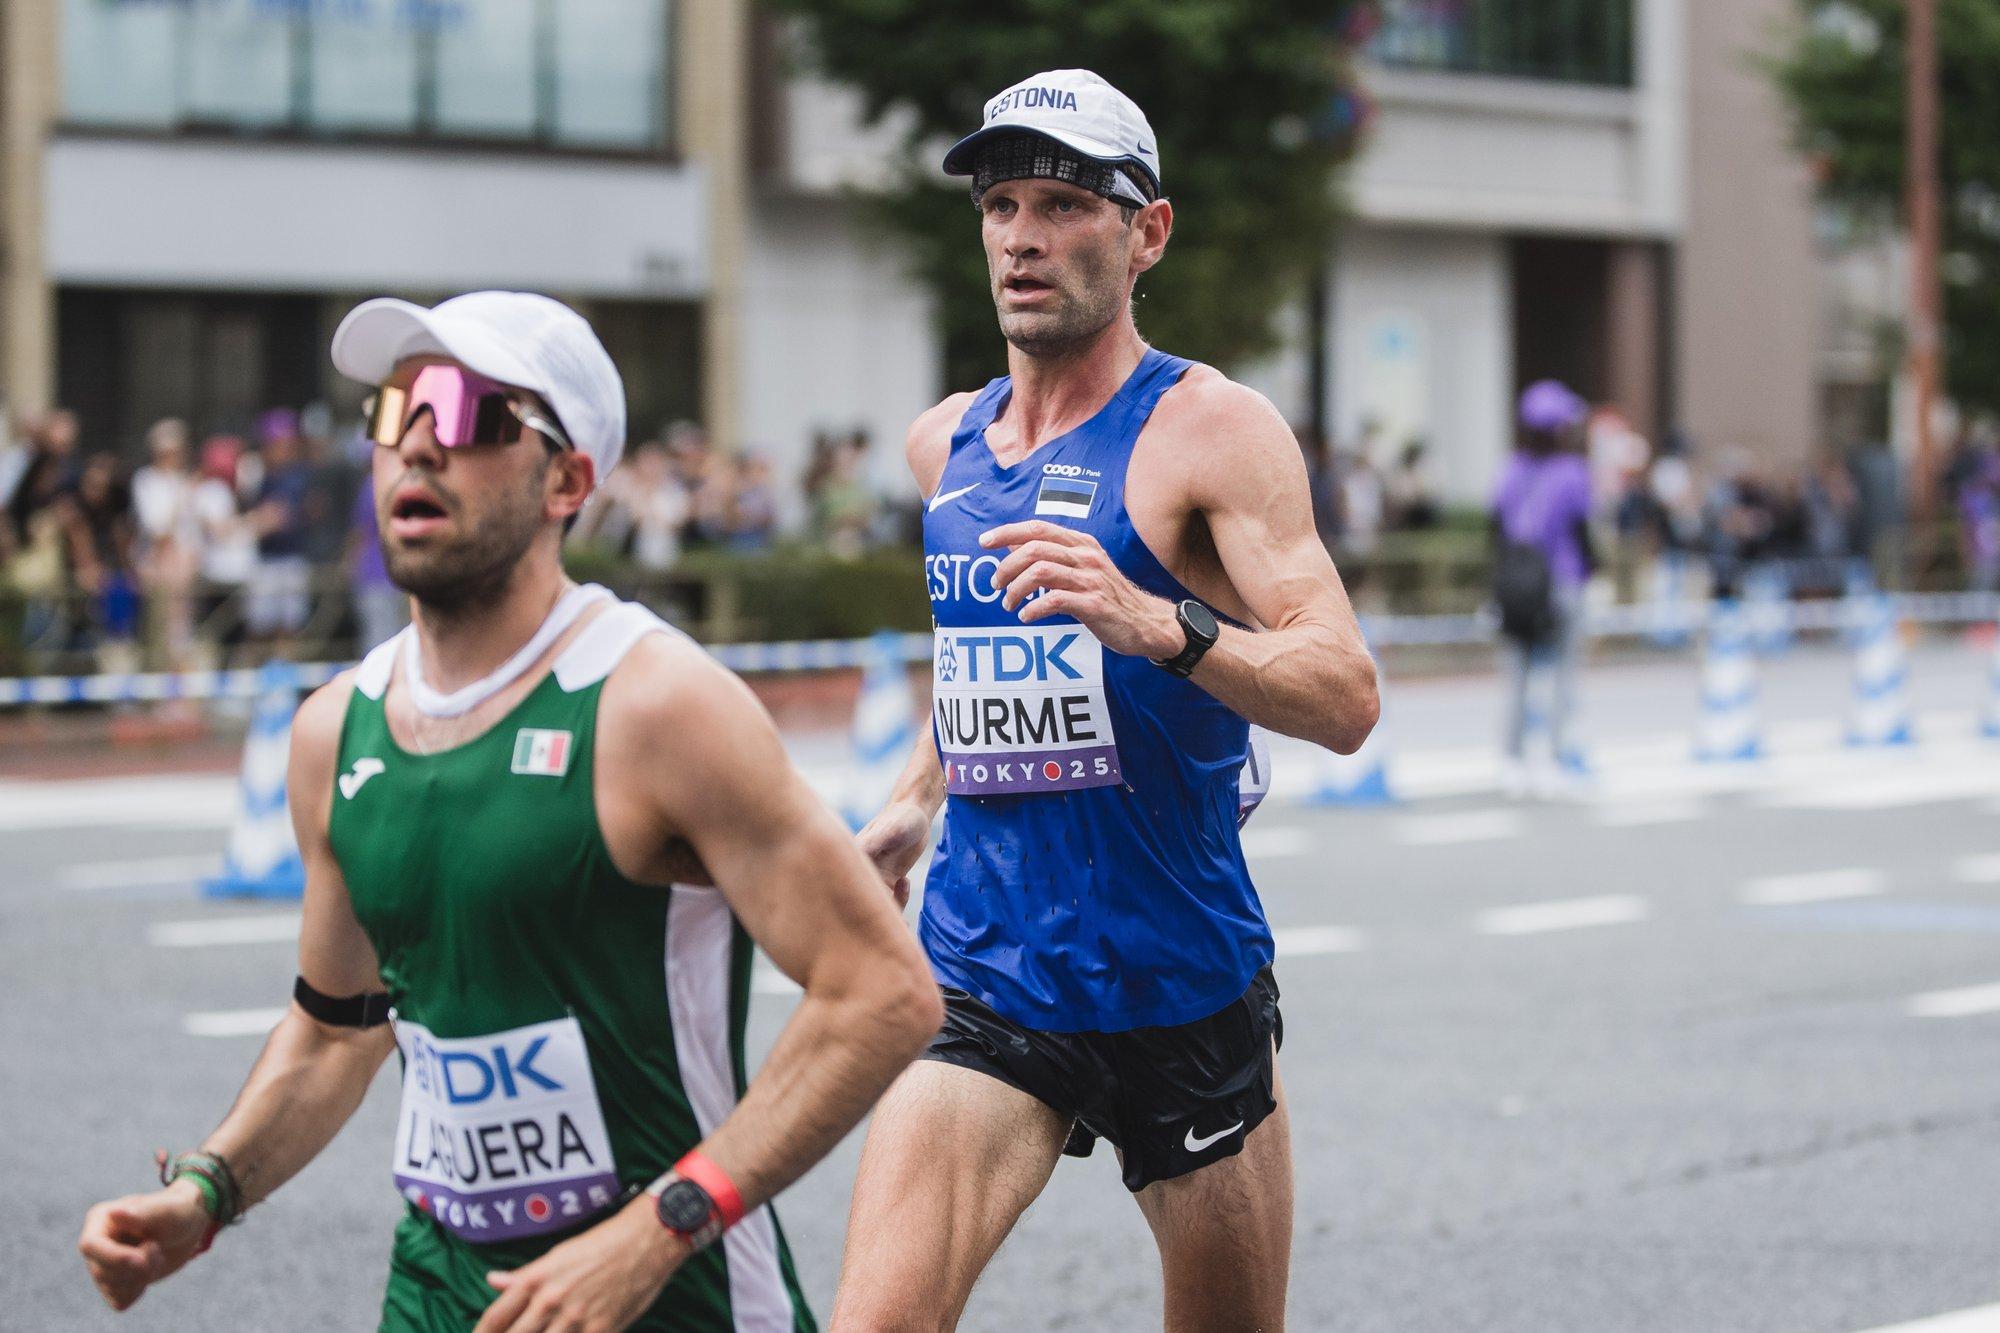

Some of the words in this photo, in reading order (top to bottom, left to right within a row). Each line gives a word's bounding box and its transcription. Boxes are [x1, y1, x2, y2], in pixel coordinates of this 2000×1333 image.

[991, 87, 1077, 120] ESTONIA
[956, 633, 1085, 682] TDK
[938, 695, 1097, 746] NURME
